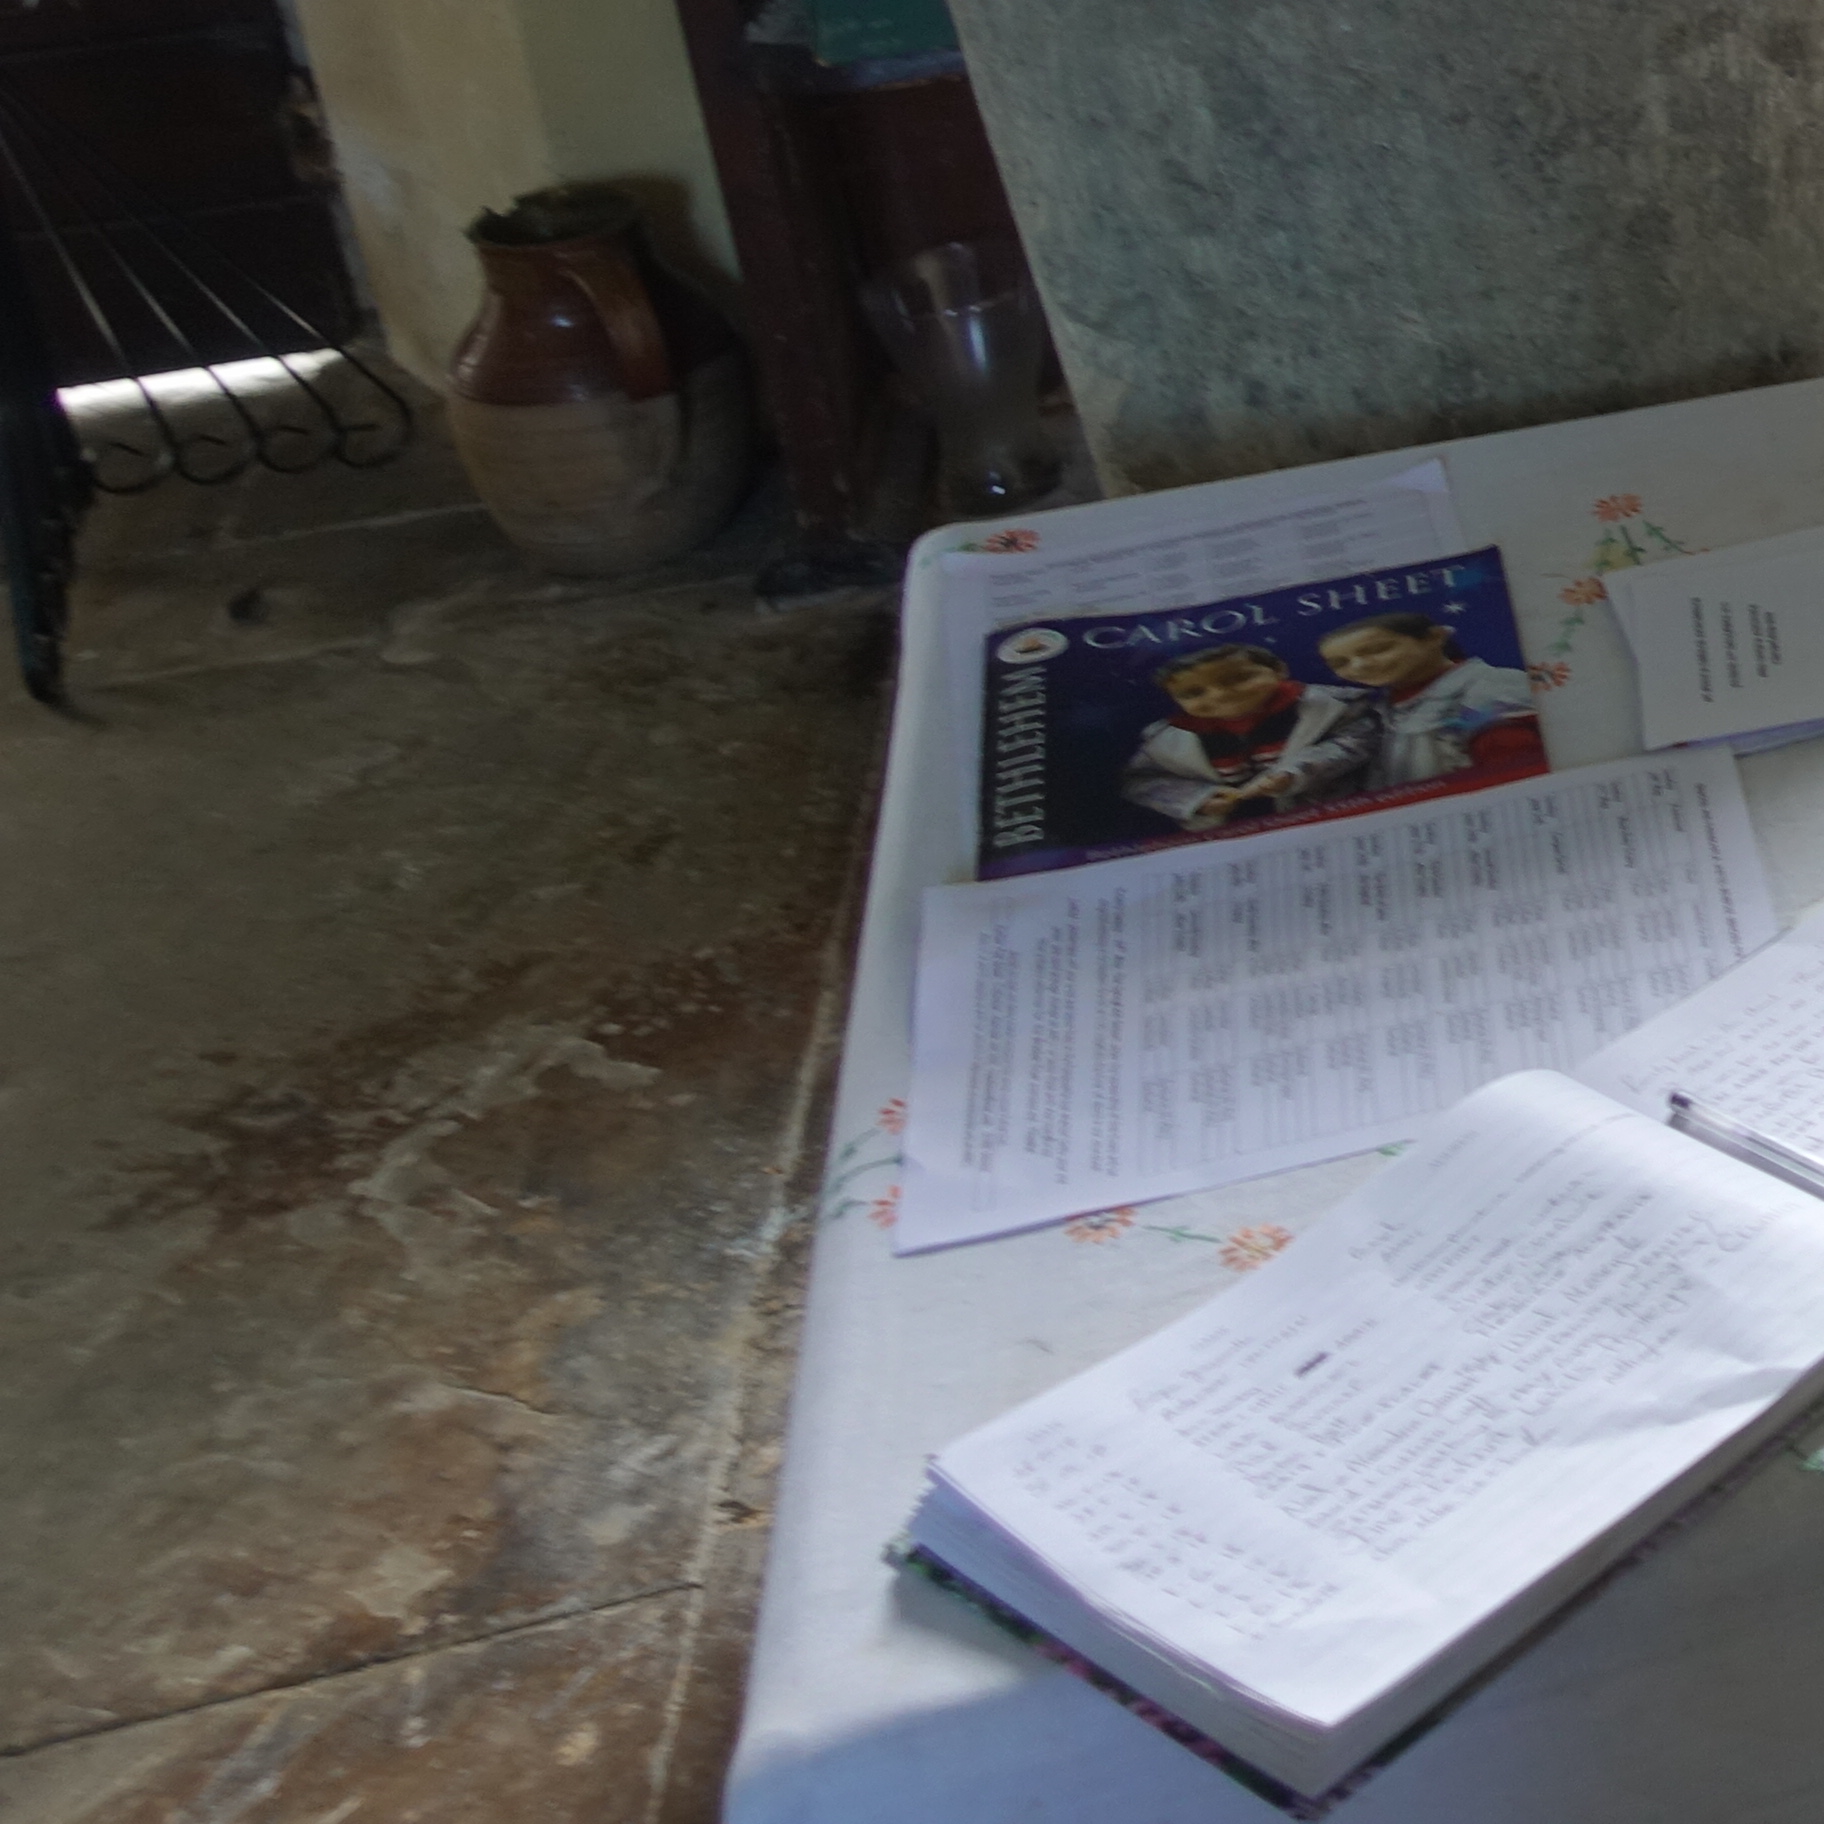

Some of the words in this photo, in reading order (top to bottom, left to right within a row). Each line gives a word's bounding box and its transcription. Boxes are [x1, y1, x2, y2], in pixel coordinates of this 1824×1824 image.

[1081, 601, 1280, 650] CAROL
[1297, 564, 1466, 617] SHEET
[993, 665, 1048, 849] BETHLEHEM
